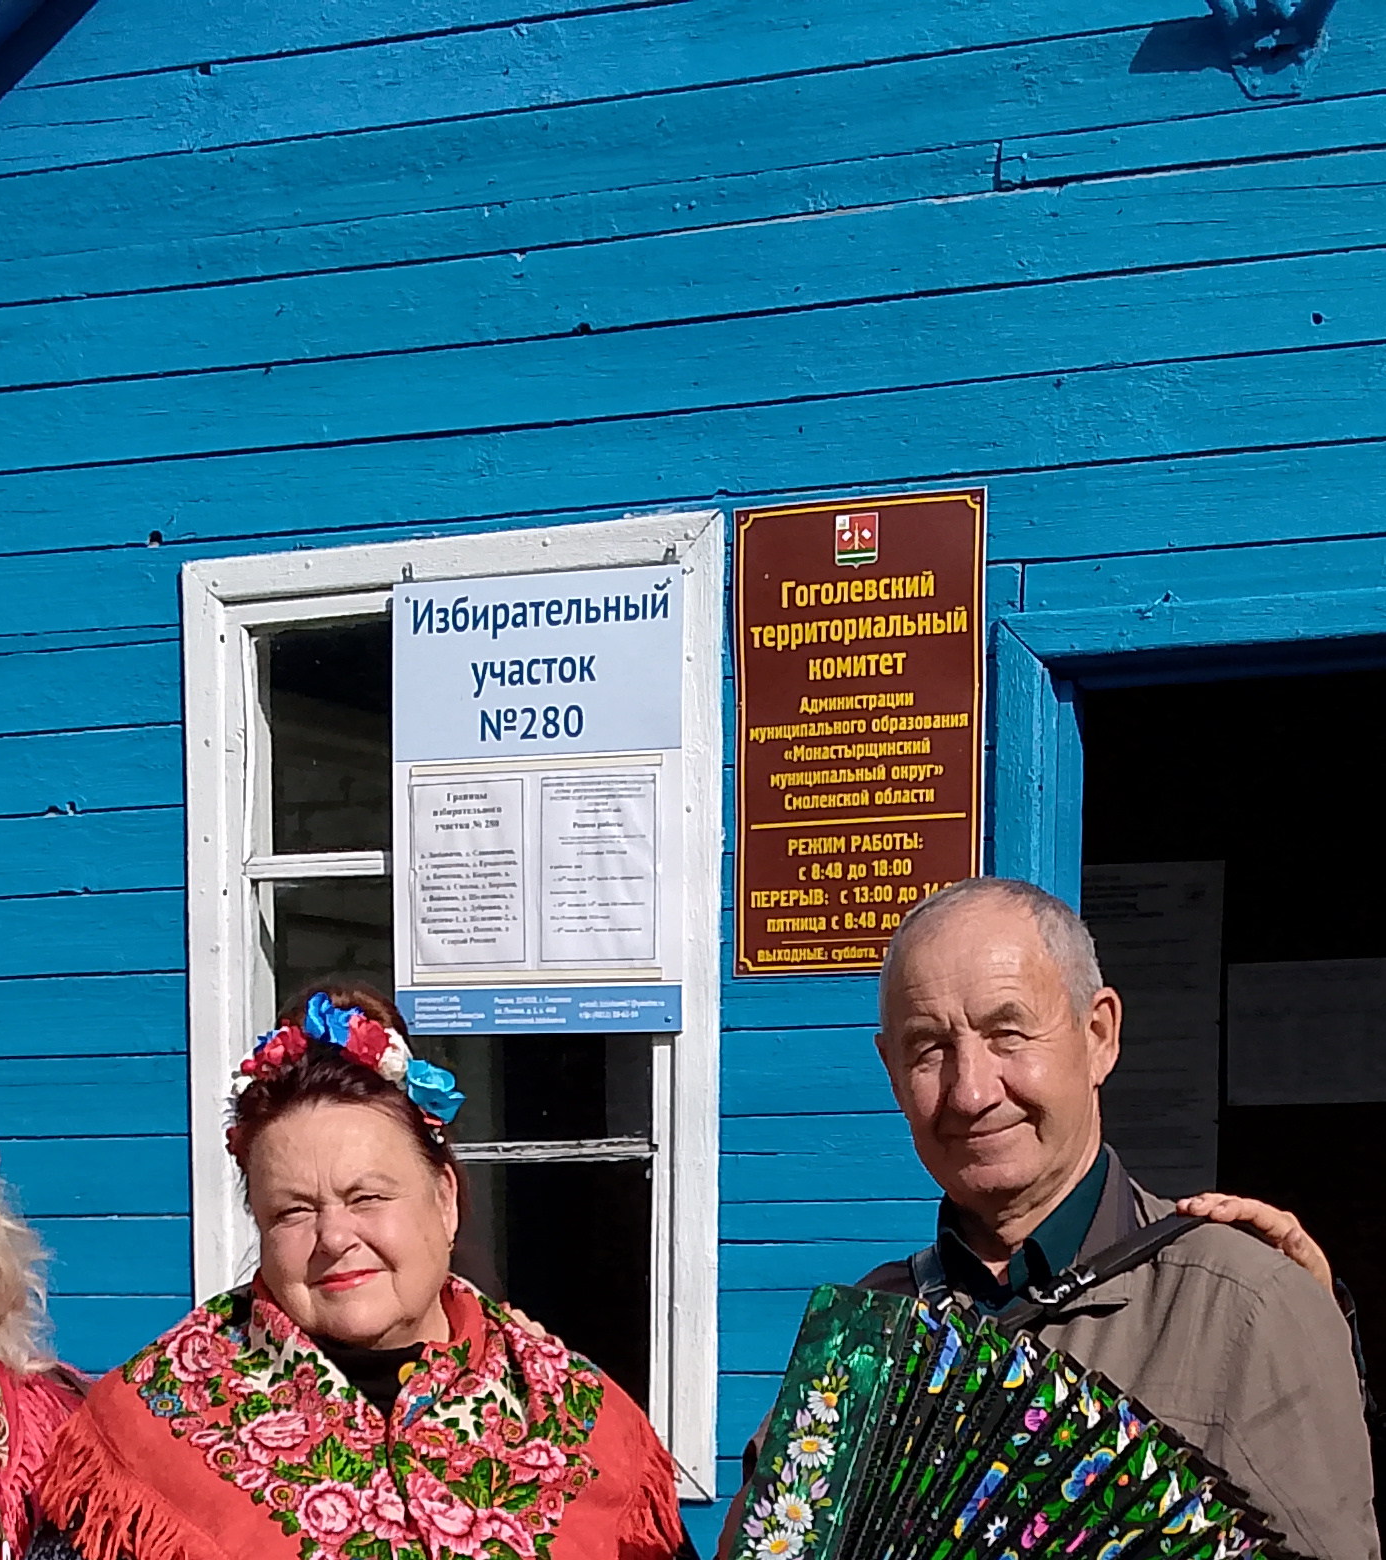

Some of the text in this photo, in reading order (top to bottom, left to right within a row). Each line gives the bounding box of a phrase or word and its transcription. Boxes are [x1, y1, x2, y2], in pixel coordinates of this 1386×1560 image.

[782, 571, 934, 608] Гоголевский
[412, 583, 669, 639] Избирательный
[751, 606, 967, 651] территориальный
[471, 656, 595, 698] участок
[809, 652, 906, 680] комитет
[799, 693, 913, 715] Администрации
[481, 705, 583, 741] №280
[750, 713, 968, 743] муниципального образования
[784, 737, 930, 762] «Монастырщинский
[771, 764, 943, 789] муниципальный округ»
[785, 787, 934, 810] Смоленской области
[788, 833, 923, 856] РЕЖИМ РАБОТЫ:
[799, 859, 911, 880] с 8:48 до 18:00
[751, 889, 828, 908] ПЕРЕРЫВ:
[841, 890, 848, 904] с
[853, 885, 892, 903] 13:00
[897, 887, 917, 903] до
[767, 912, 900, 933] пятница с 8:48 до
[758, 946, 878, 962] ВЫХОДНЫЕ: суббота,
